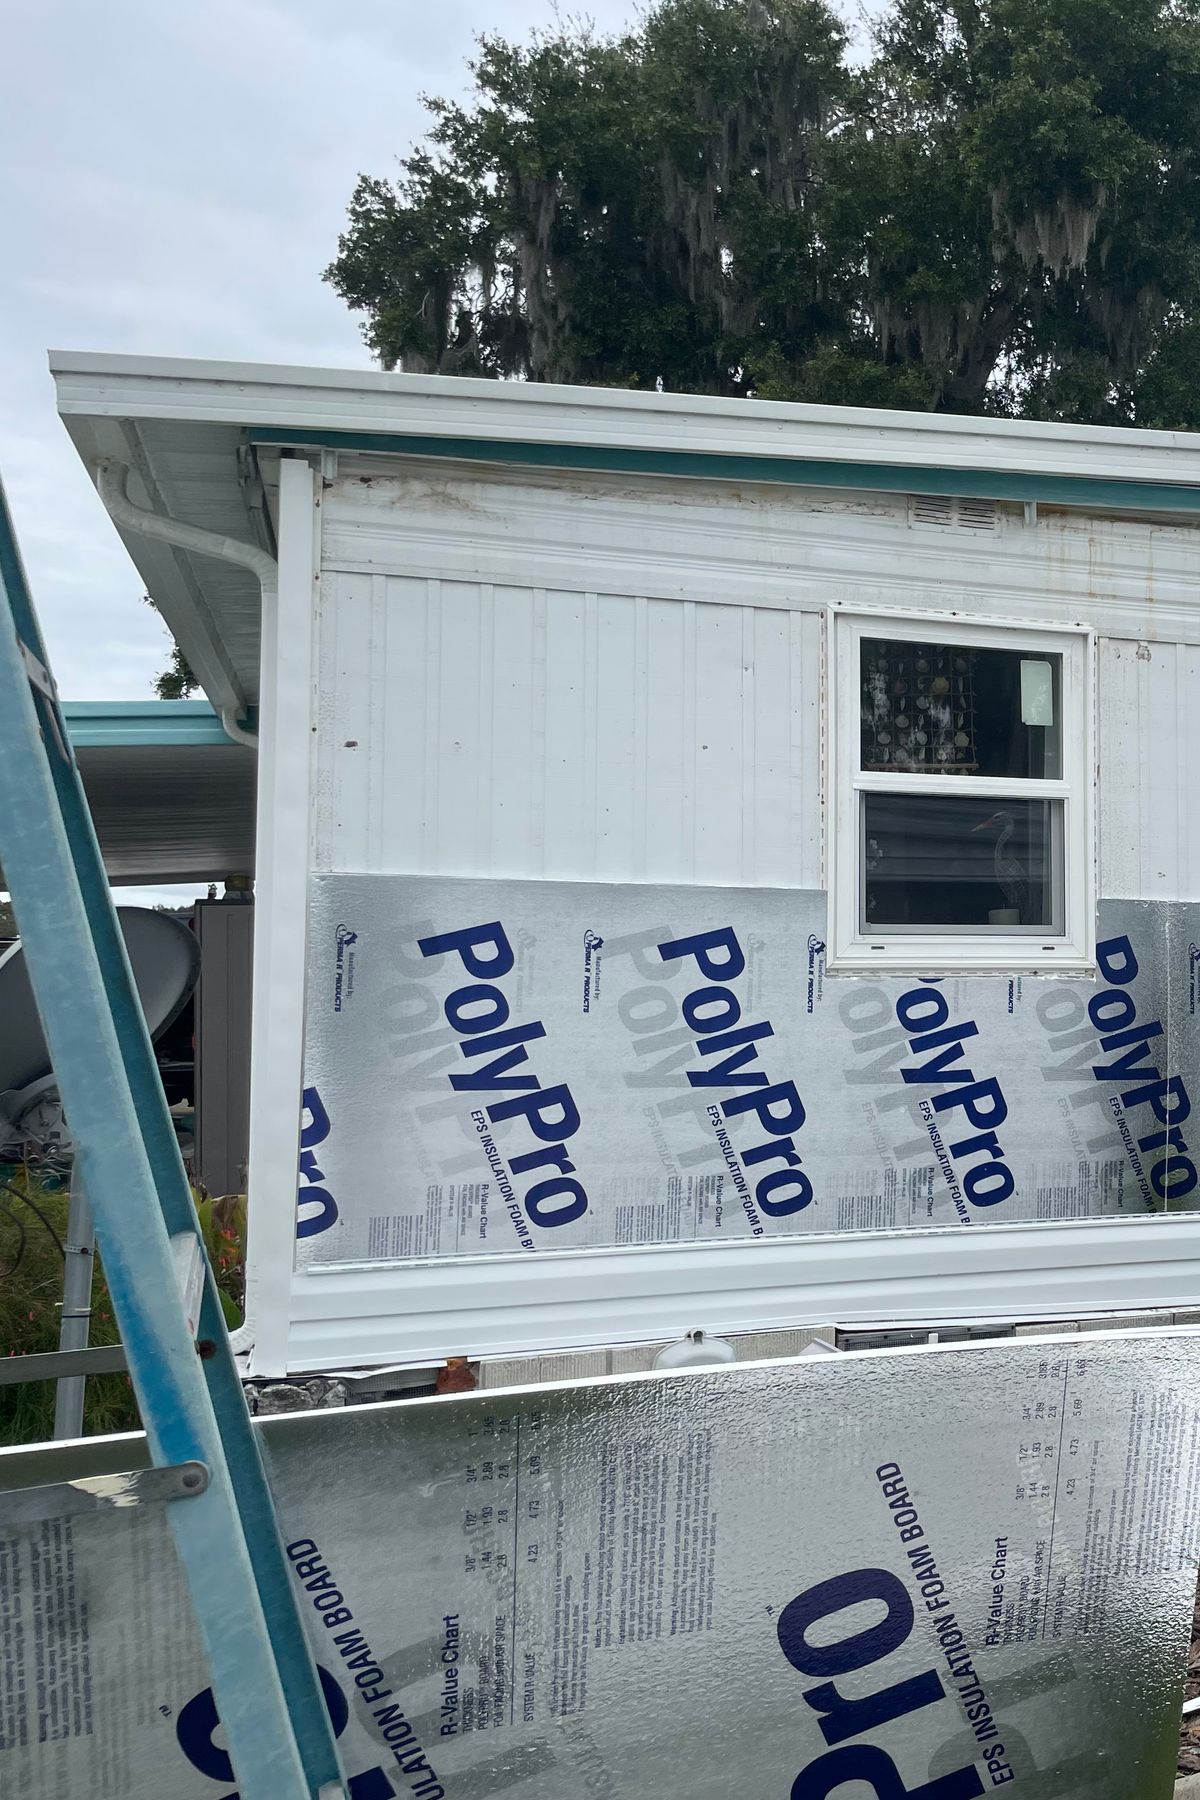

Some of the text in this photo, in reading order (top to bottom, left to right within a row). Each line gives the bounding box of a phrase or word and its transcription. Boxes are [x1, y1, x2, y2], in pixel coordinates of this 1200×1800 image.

[335, 937, 344, 963] PERMA
[347, 952, 355, 990] Manufactured
[584, 942, 592, 966] PERMA
[594, 956, 602, 991] Manufactured
[334, 972, 343, 1013] PRODUCTS
[416, 921, 588, 1228] PolyPro
[657, 927, 814, 1218] PolyPro
[895, 979, 1015, 1208] olyPro
[470, 1110, 489, 1133] EPS
[480, 1134, 516, 1203] INSULATION
[506, 1201, 529, 1238] FOAM
[706, 1105, 723, 1127] EPS
[715, 1128, 748, 1193] INSULATION
[740, 1193, 760, 1226] FOAM
[918, 1100, 933, 1122] EPS
[926, 1123, 957, 1185] INSULATION
[949, 1184, 968, 1216] FOAM
[1109, 1096, 1123, 1117] EPS
[1116, 1118, 1144, 1177] INSULATION
[1138, 1177, 1156, 1207] FOAM
[479, 1184, 489, 1239] R-Value Chart
[714, 1175, 724, 1228] R-Value Chart
[926, 1167, 935, 1217] R-Value Chart
[1035, 1402, 1044, 1419] 2.89
[1048, 1406, 1057, 1418] 2.8
[1073, 1399, 1083, 1416] 5.69
[483, 1461, 493, 1480] 2.89
[499, 1465, 509, 1479] 2.8
[1044, 1446, 1054, 1458] 2.8
[498, 1509, 508, 1523] 2.8
[286, 1538, 354, 1629] BOARD
[524, 1689, 534, 1722] SYSTEM
[530, 1456, 541, 1475] 5.69
[985, 1536, 1008, 1646] R-Value Chart
[496, 1615, 506, 1641] SPACE
[875, 1462, 1014, 1786] EPS INSULATION FOAM BOARD
[333, 1628, 392, 1704] FOAM
[440, 1614, 460, 1736] R-Value Chart
